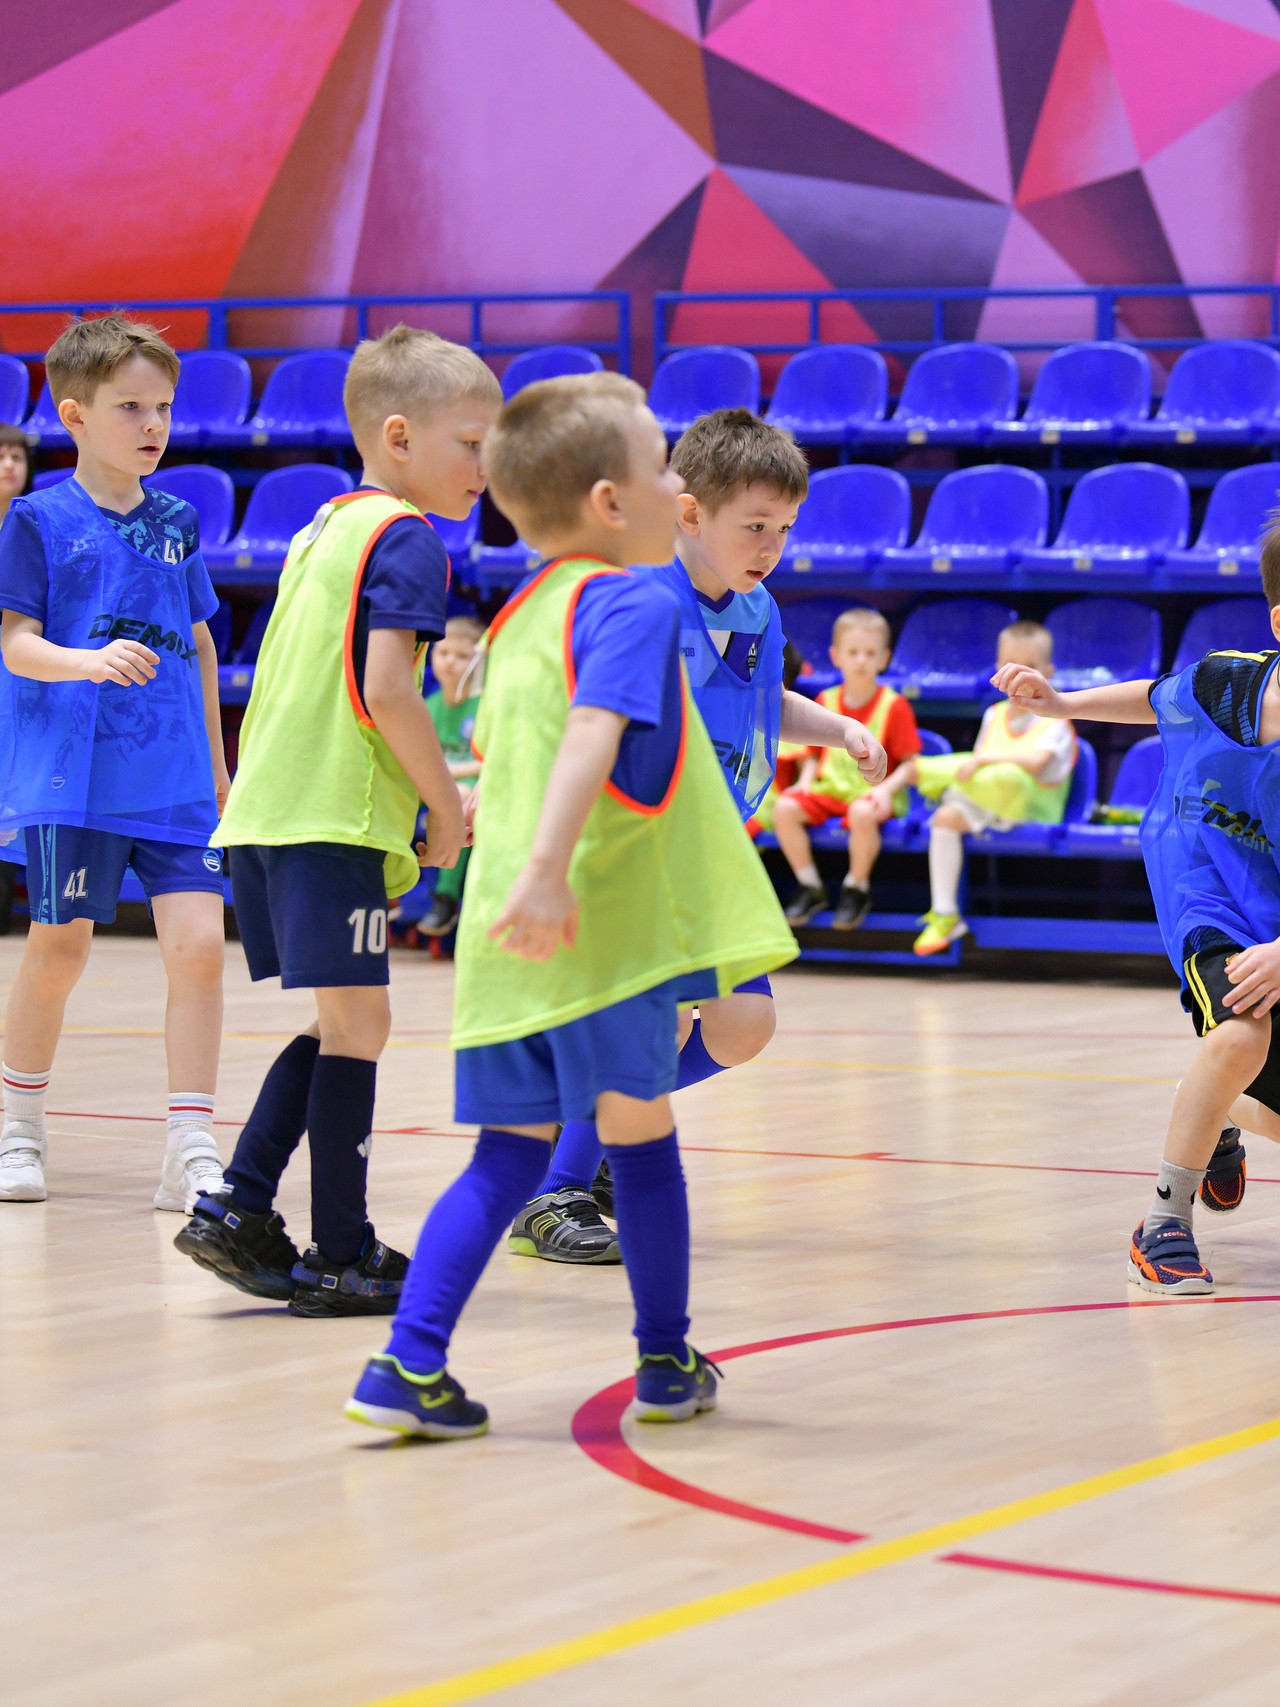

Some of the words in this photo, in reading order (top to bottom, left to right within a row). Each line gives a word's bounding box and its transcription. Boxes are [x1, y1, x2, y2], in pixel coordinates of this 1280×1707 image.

[164, 539, 184, 565] 41
[63, 868, 88, 901] 41
[347, 908, 387, 954] 10
